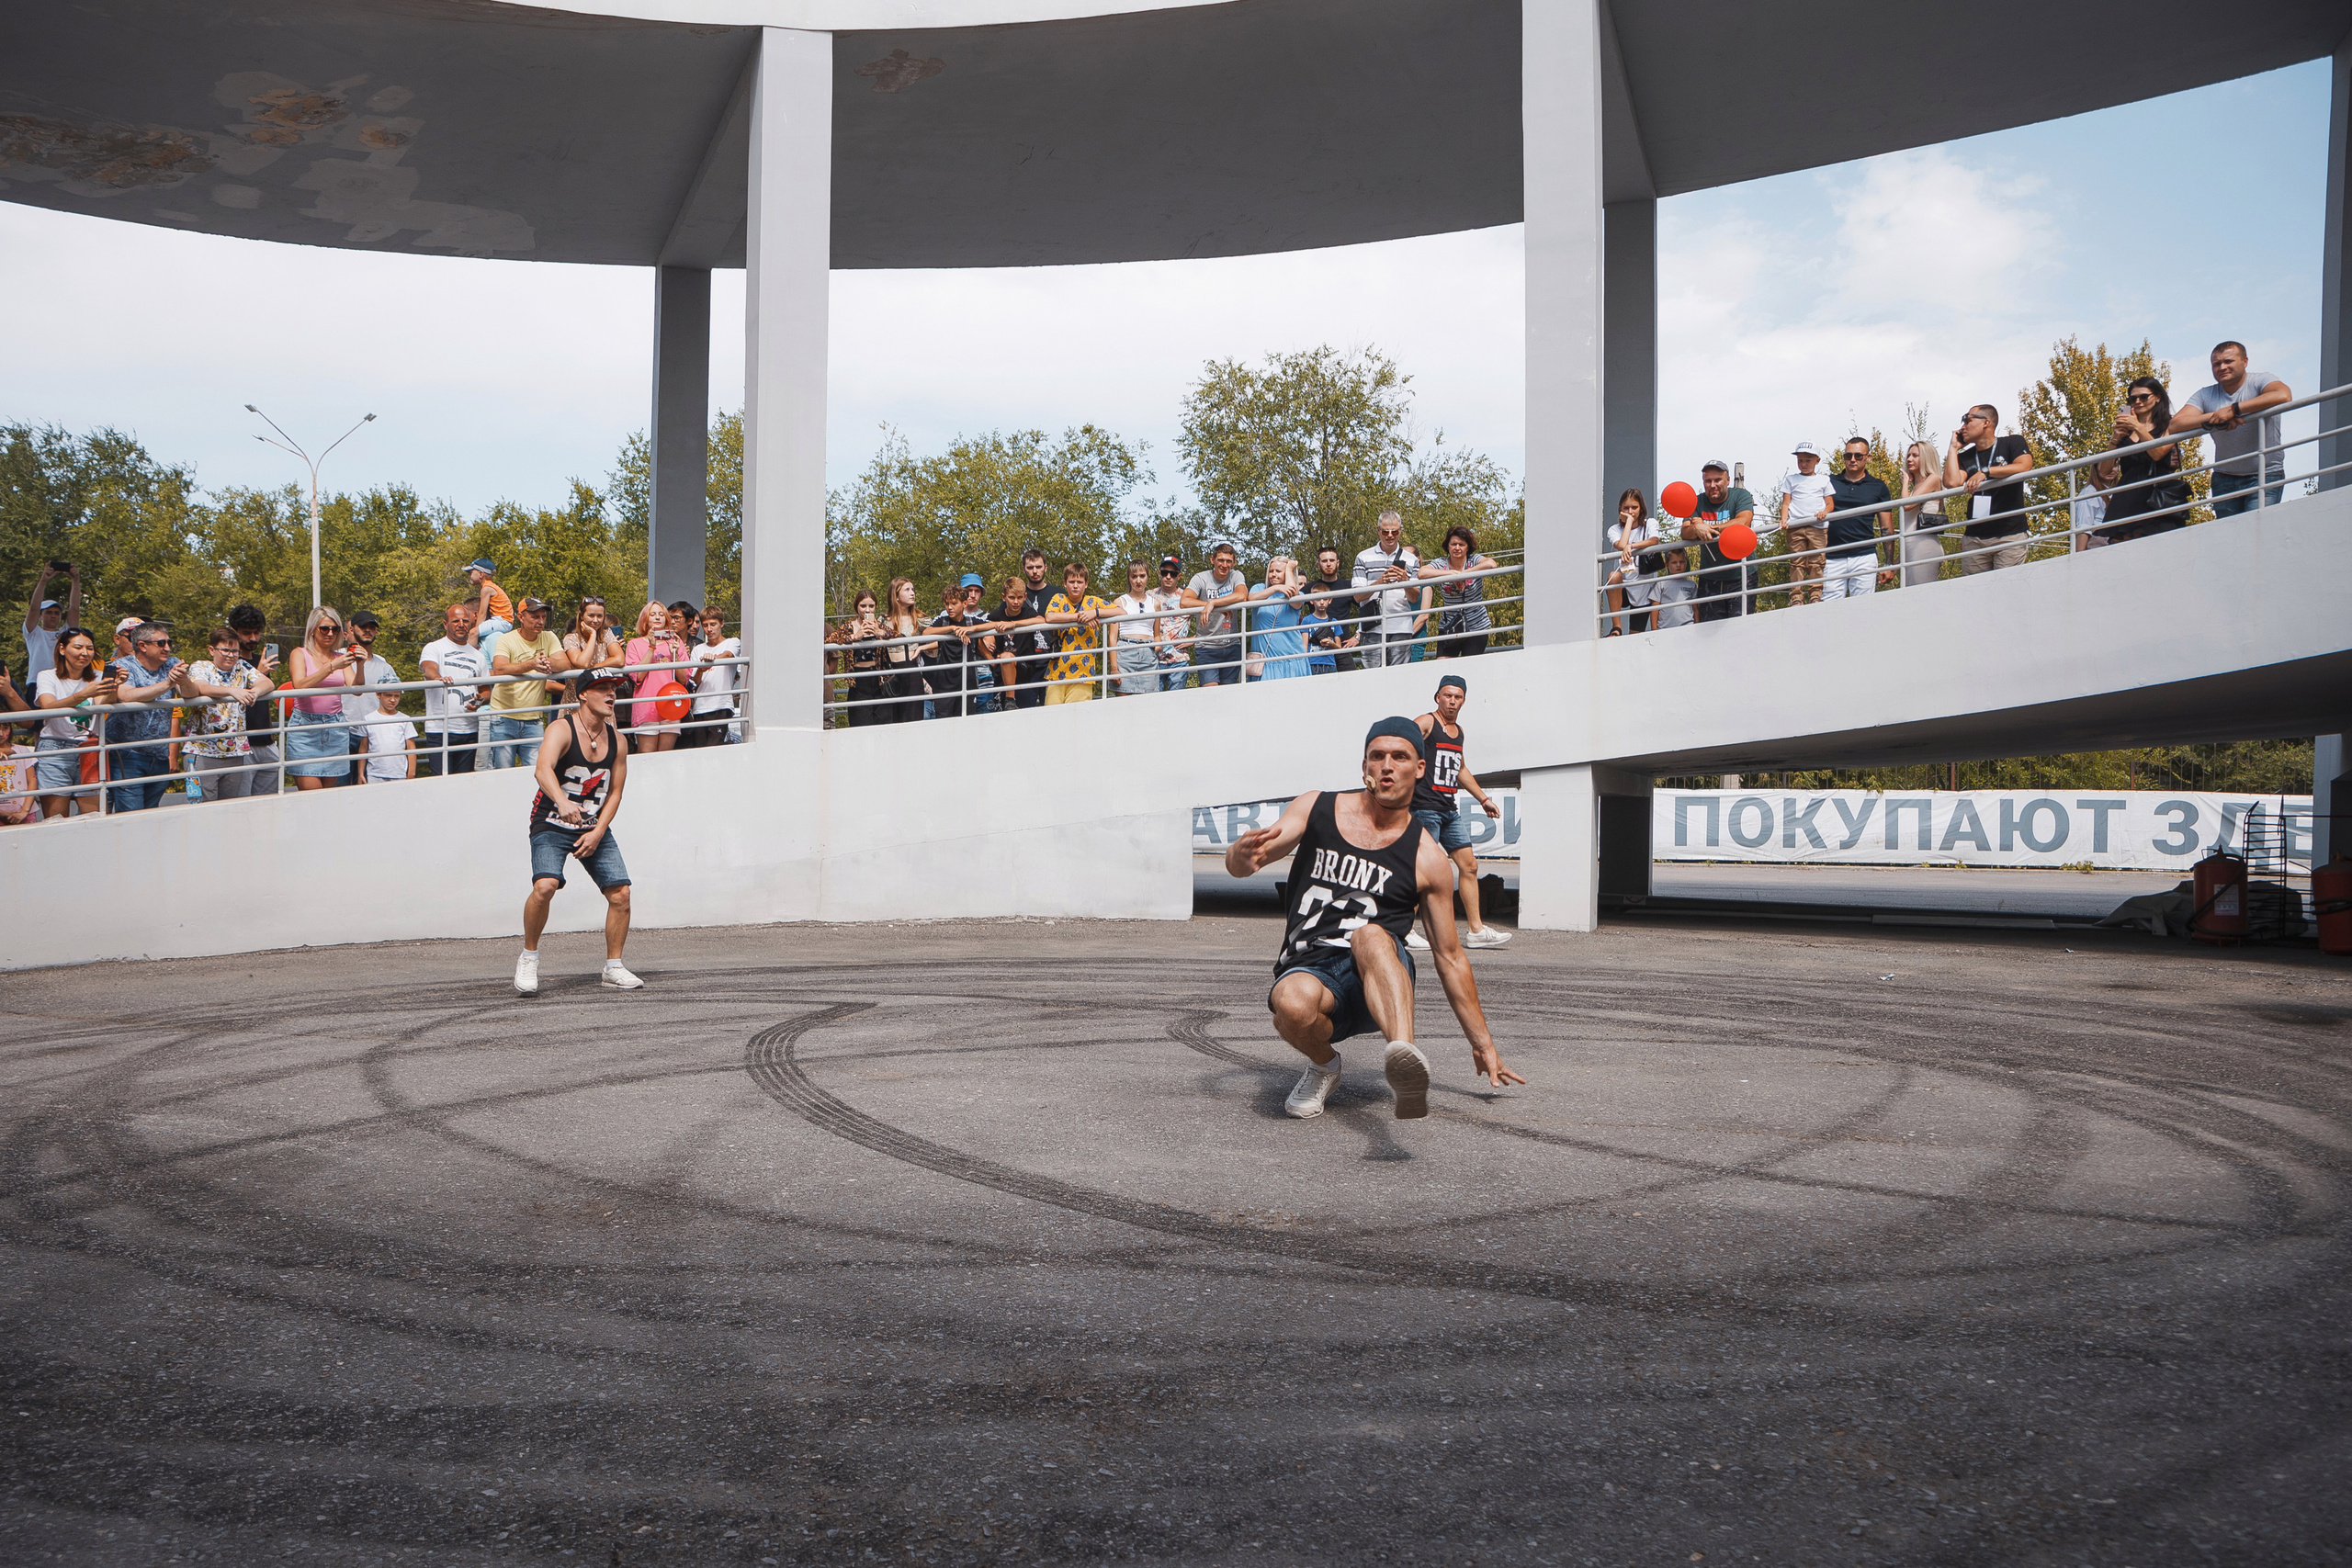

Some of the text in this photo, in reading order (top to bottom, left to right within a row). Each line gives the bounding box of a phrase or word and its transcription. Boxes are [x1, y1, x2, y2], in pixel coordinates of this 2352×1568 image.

[554, 765, 611, 816] 23
[1674, 796, 2126, 854] ПОКУПАЮТ
[1310, 848, 1393, 897] BRONX
